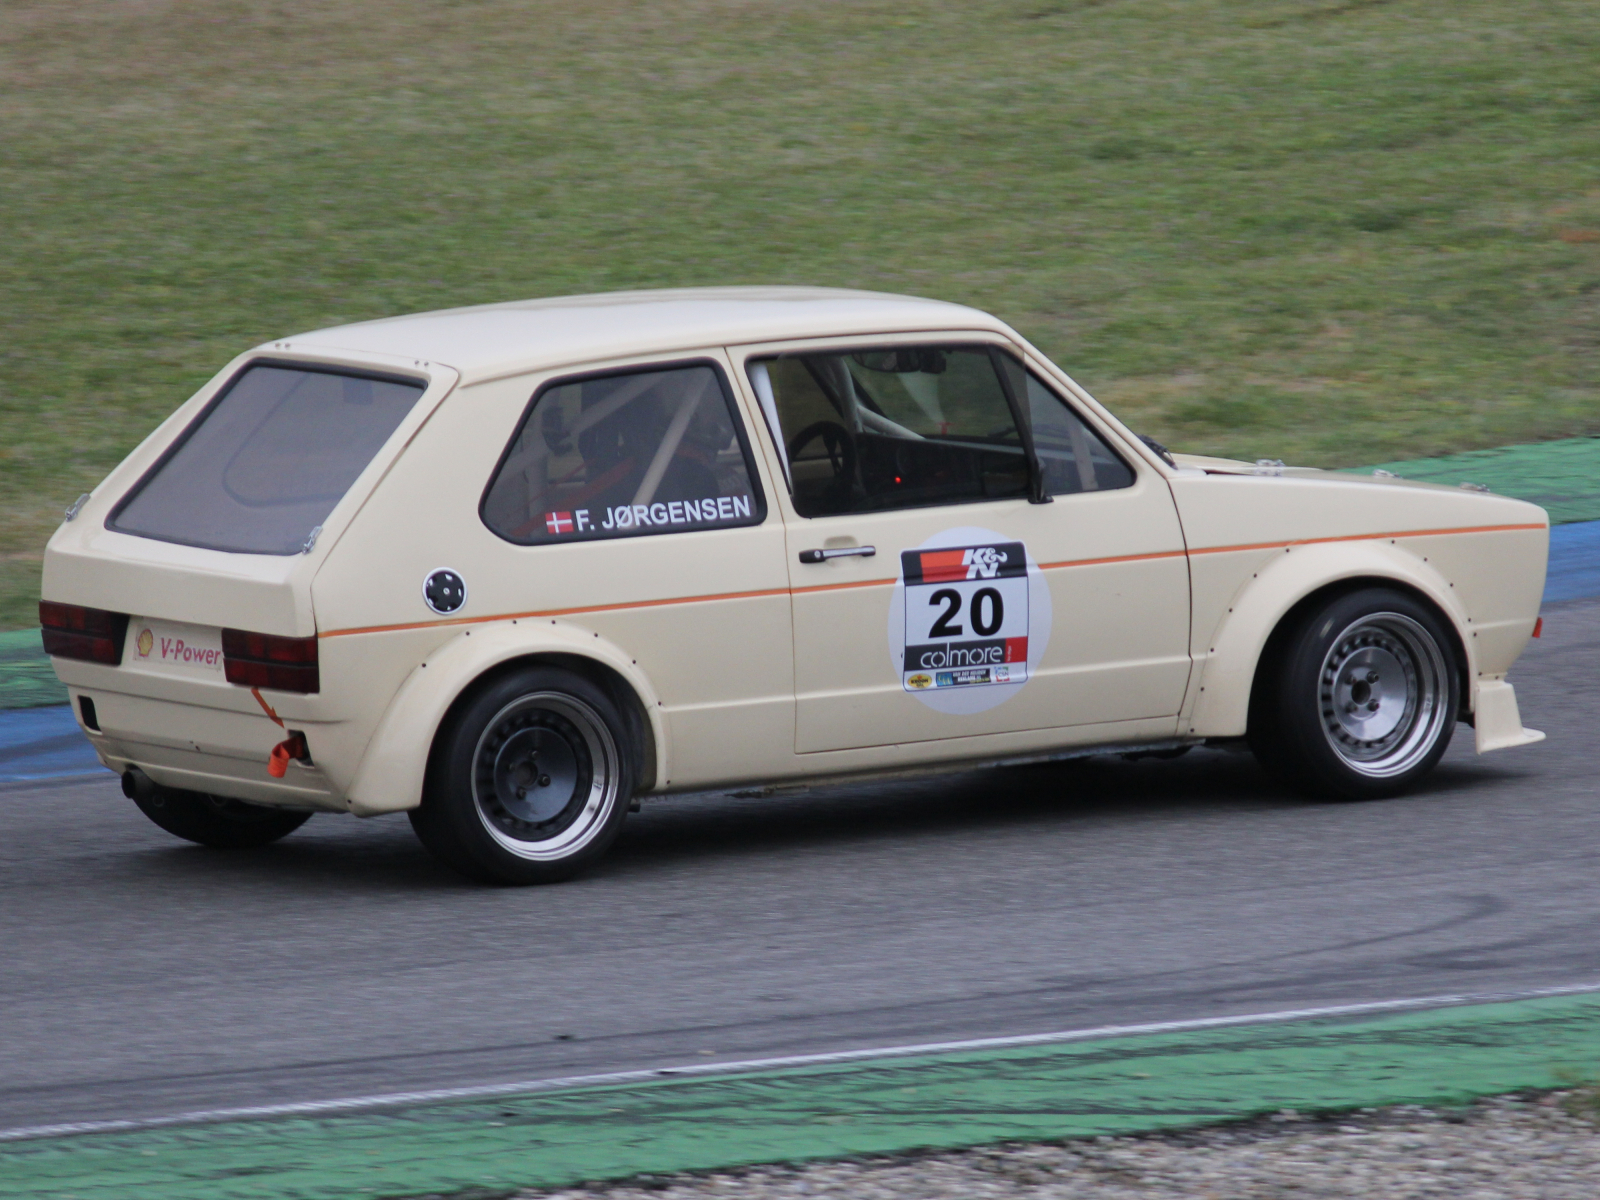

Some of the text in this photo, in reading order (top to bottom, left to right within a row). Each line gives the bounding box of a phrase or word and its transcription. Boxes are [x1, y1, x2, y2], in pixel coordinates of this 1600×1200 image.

[575, 495, 750, 531] F. JØRGENSEN
[928, 587, 1004, 638] 20
[161, 637, 221, 665] V-Power
[920, 642, 1003, 669] colmore
